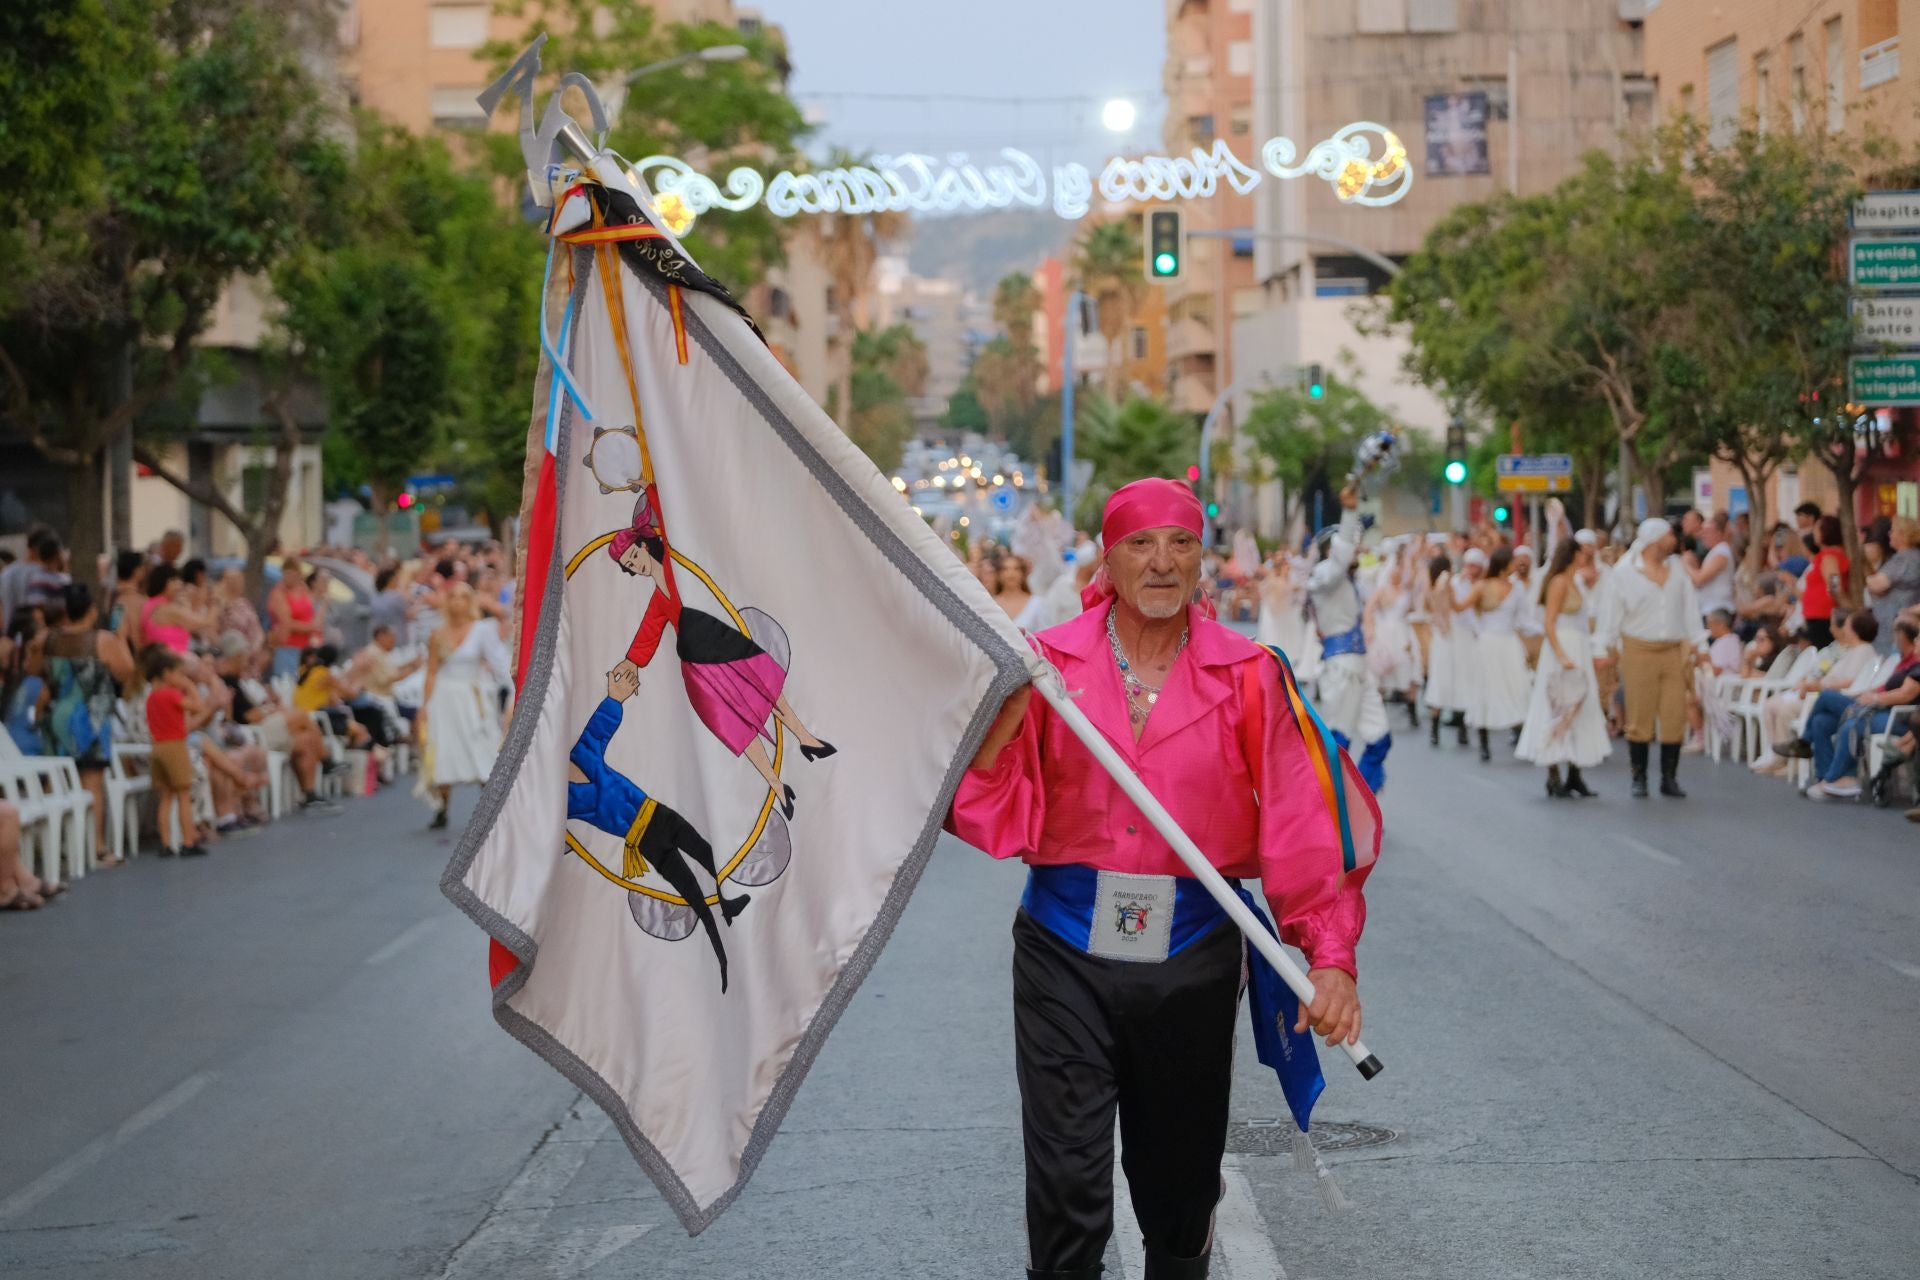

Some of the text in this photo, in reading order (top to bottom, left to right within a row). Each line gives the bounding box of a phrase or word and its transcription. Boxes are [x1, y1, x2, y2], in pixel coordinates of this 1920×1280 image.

[1856, 245, 1917, 261] avenida
[1856, 263, 1920, 282] avingud
[1855, 363, 1916, 379] avenida
